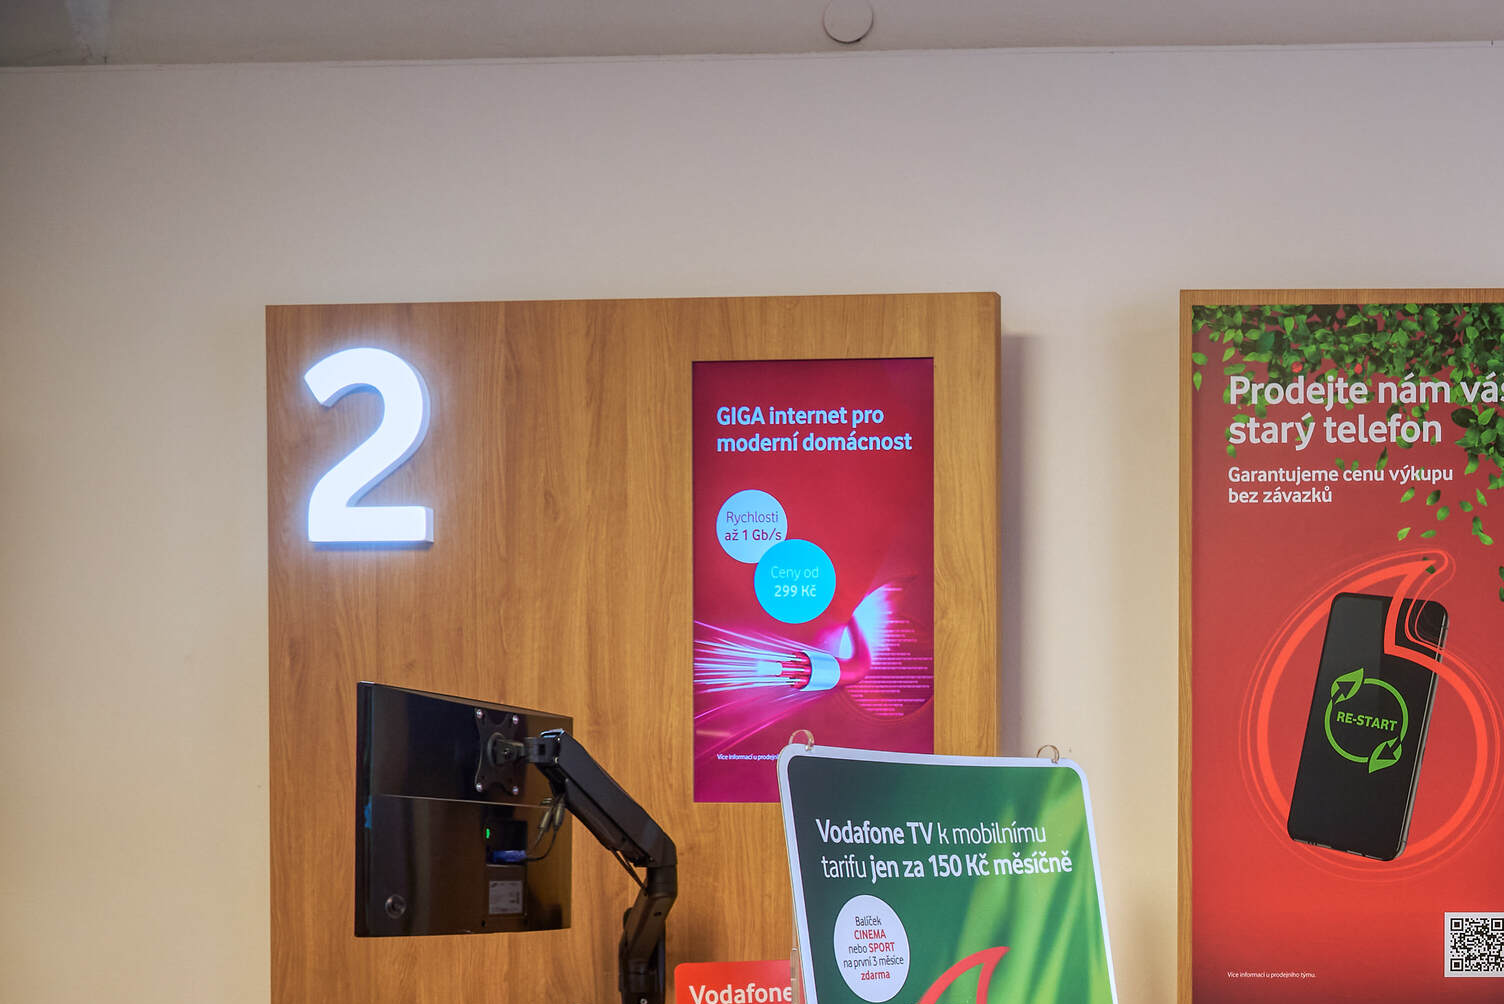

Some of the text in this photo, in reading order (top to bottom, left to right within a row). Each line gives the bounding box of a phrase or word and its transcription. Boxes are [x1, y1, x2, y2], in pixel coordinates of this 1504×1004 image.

[1229, 375, 1368, 412] Prodejte
[1378, 372, 1450, 404] nám
[716, 406, 884, 428] GIGA internet pro
[1229, 412, 1442, 451] starý telefon
[304, 347, 434, 545] 2
[716, 430, 913, 452] moderní domácnost
[1228, 465, 1453, 485] Garantujeme cenu výkupu
[1228, 485, 1333, 504] bez závazků
[726, 511, 779, 526] Rychlosti
[725, 528, 782, 542] až 1 Gb/s
[771, 566, 819, 580] Ceny od
[774, 584, 817, 598] 299 Kč
[1336, 710, 1398, 732] RE-START
[816, 818, 1046, 845] Vodafone TV k mobilnímu
[821, 850, 1073, 884] tarifu jen za 150 Kč měsíčně
[855, 916, 882, 927] Balíček
[854, 929, 887, 940] CINEMA
[848, 942, 895, 953] nebo SPORT
[843, 955, 904, 970] na první 3 měsíce
[861, 970, 891, 981] zdarma
[1270, 971, 1300, 979] prodejního
